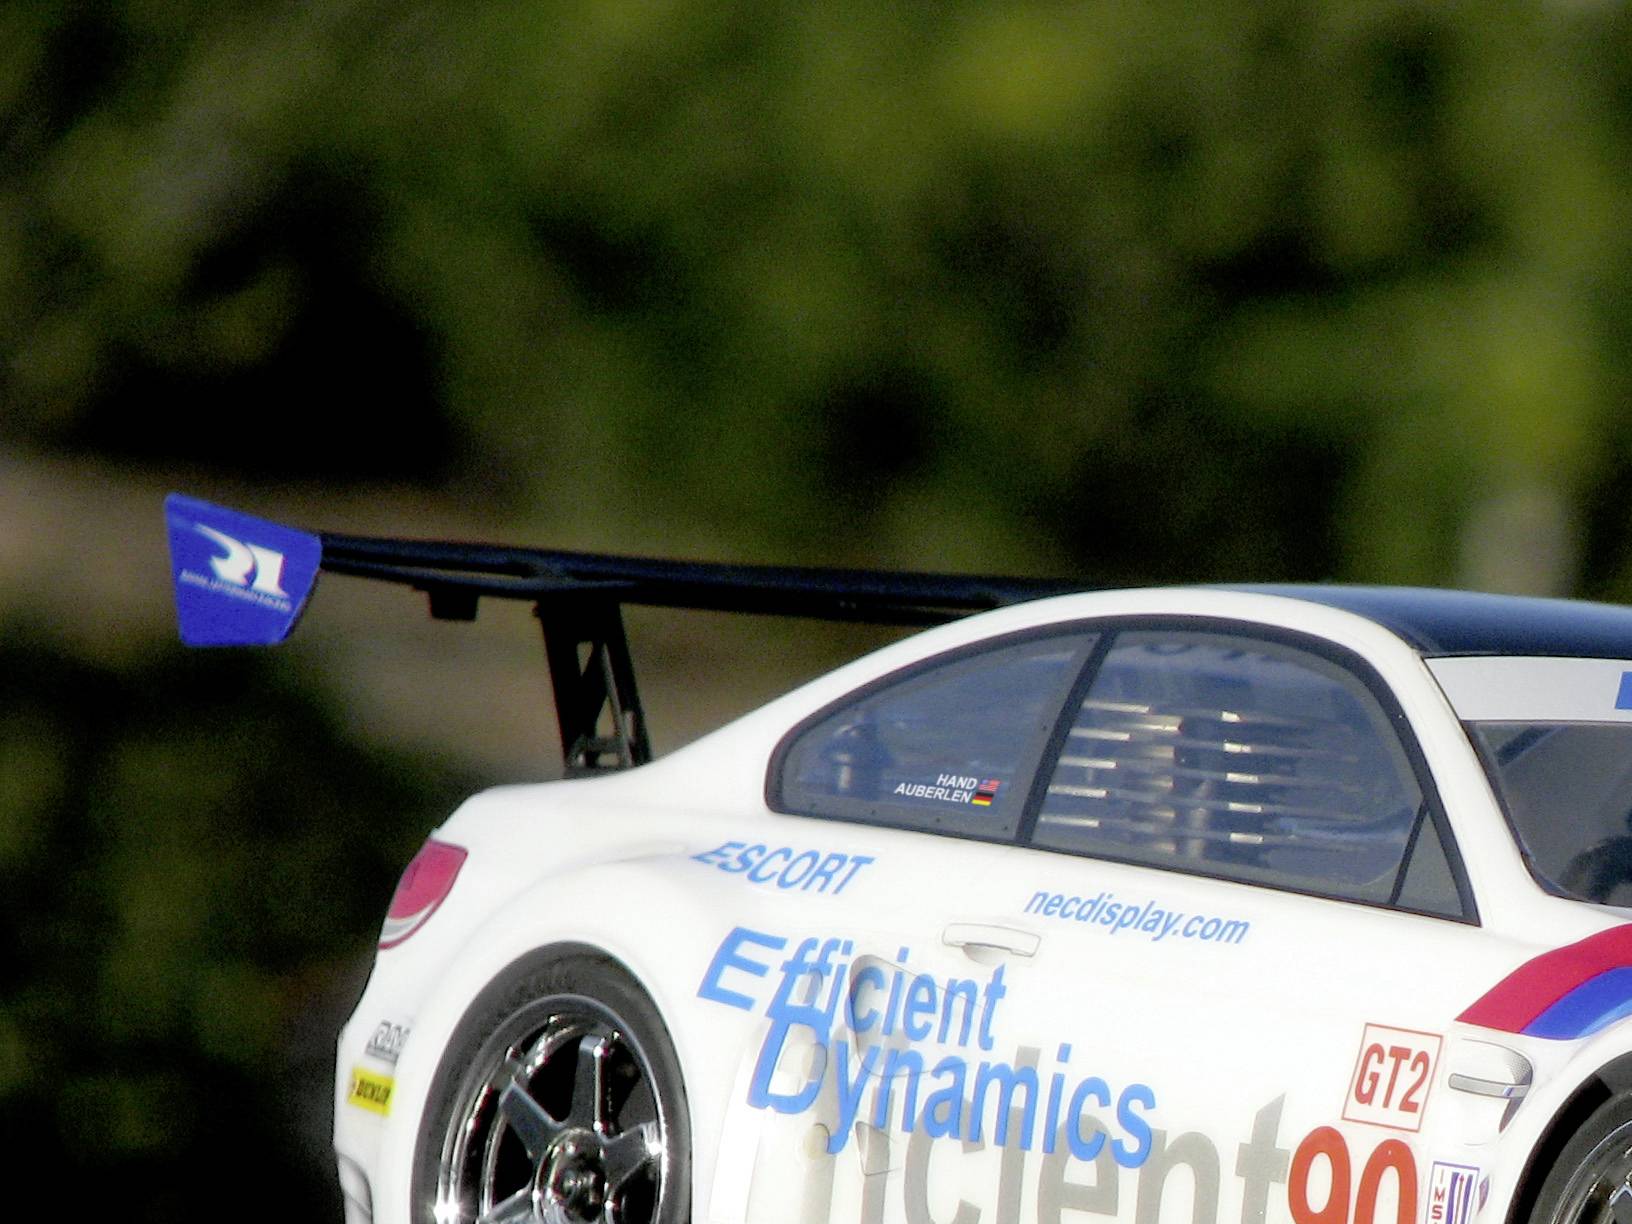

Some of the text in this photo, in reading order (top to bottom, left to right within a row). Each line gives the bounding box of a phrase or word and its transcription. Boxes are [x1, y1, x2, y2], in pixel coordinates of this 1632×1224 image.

[893, 782, 972, 804] AUBERLEN
[936, 773, 978, 790] HAND
[690, 841, 876, 896] ESCORT
[1022, 887, 1251, 945] necdisplay.com
[696, 927, 1006, 1052] Efficient
[746, 1002, 1157, 1170] Dynamics
[1354, 1042, 1430, 1114] GT2
